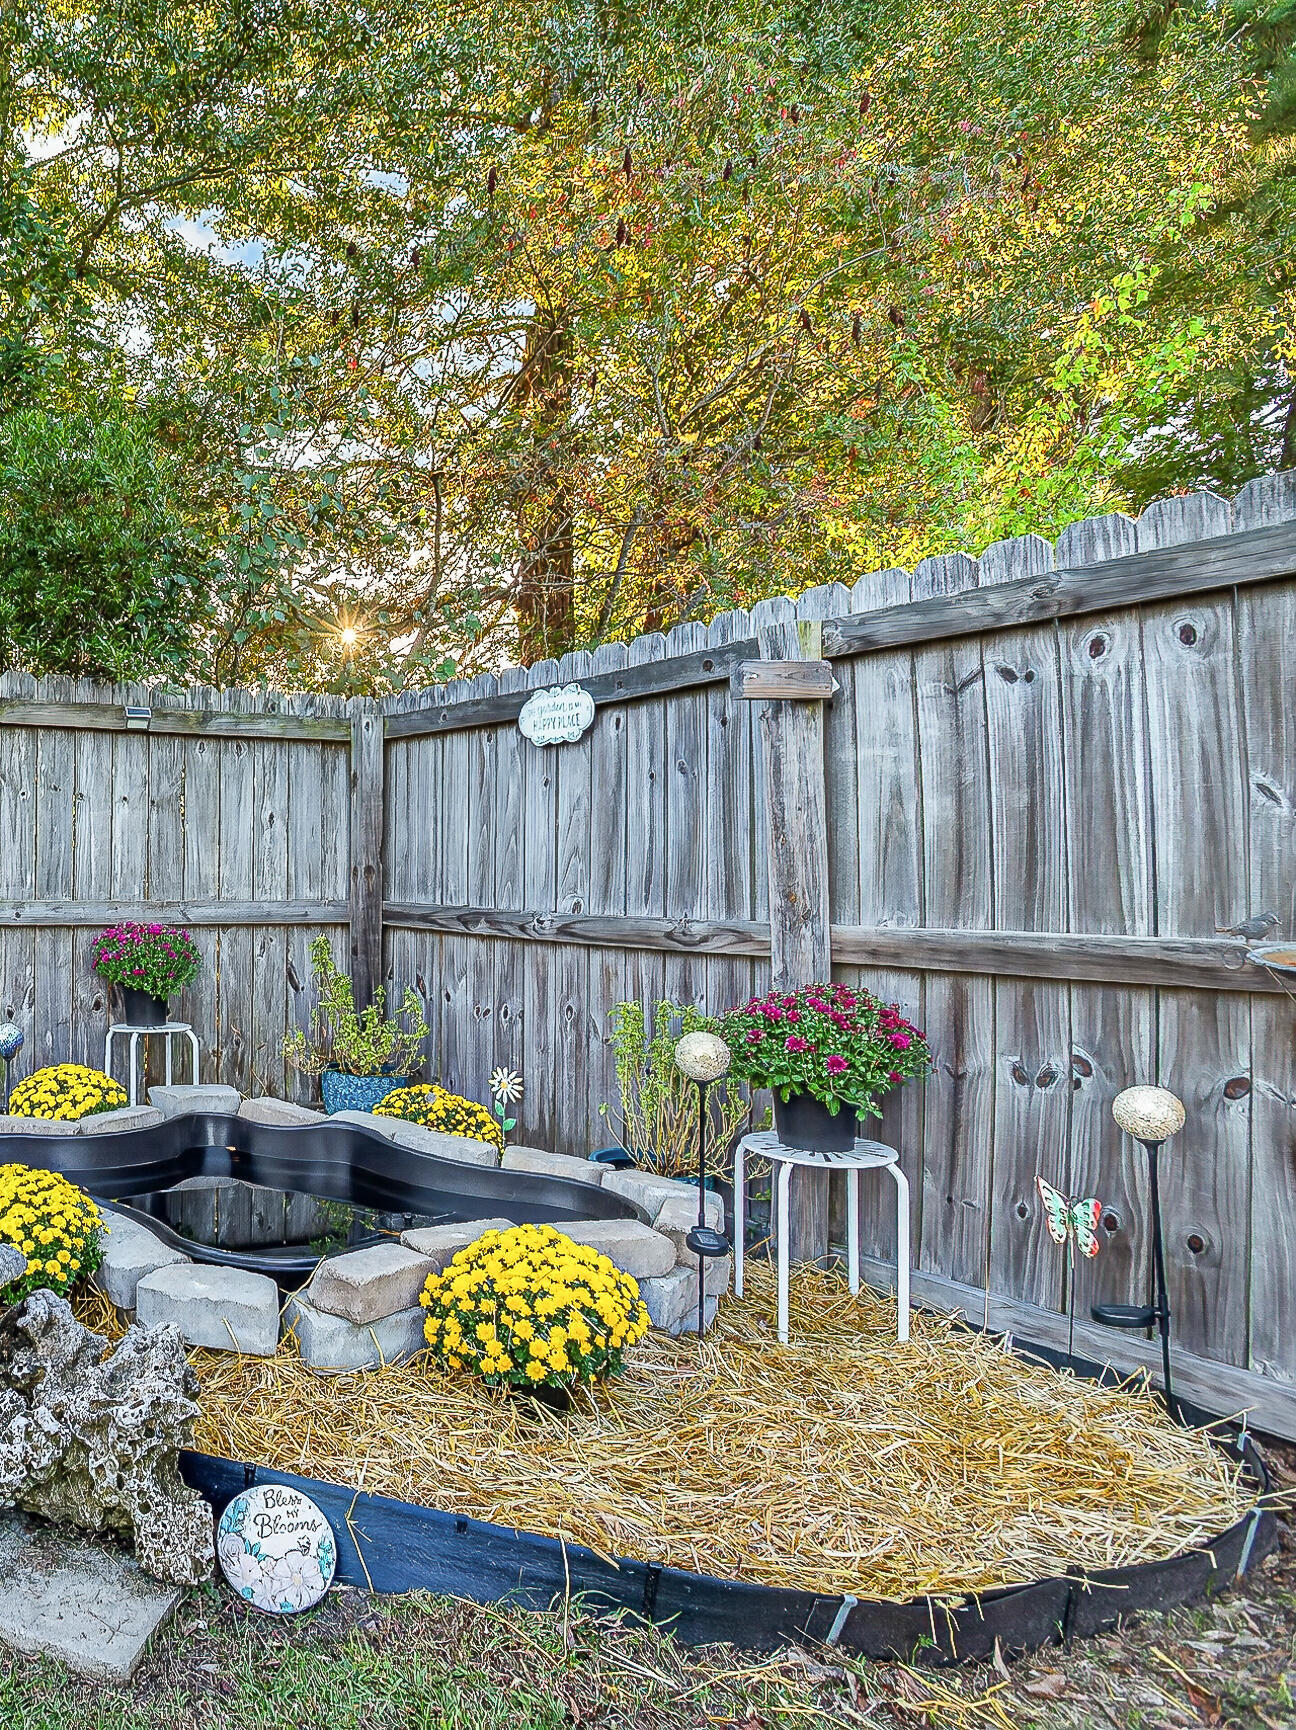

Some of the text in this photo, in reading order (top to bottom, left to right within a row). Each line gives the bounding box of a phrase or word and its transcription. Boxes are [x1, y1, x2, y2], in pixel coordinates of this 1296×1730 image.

[558, 712, 580, 730] PLACE
[263, 1488, 302, 1509] Bless
[253, 1513, 322, 1539] Blooms
